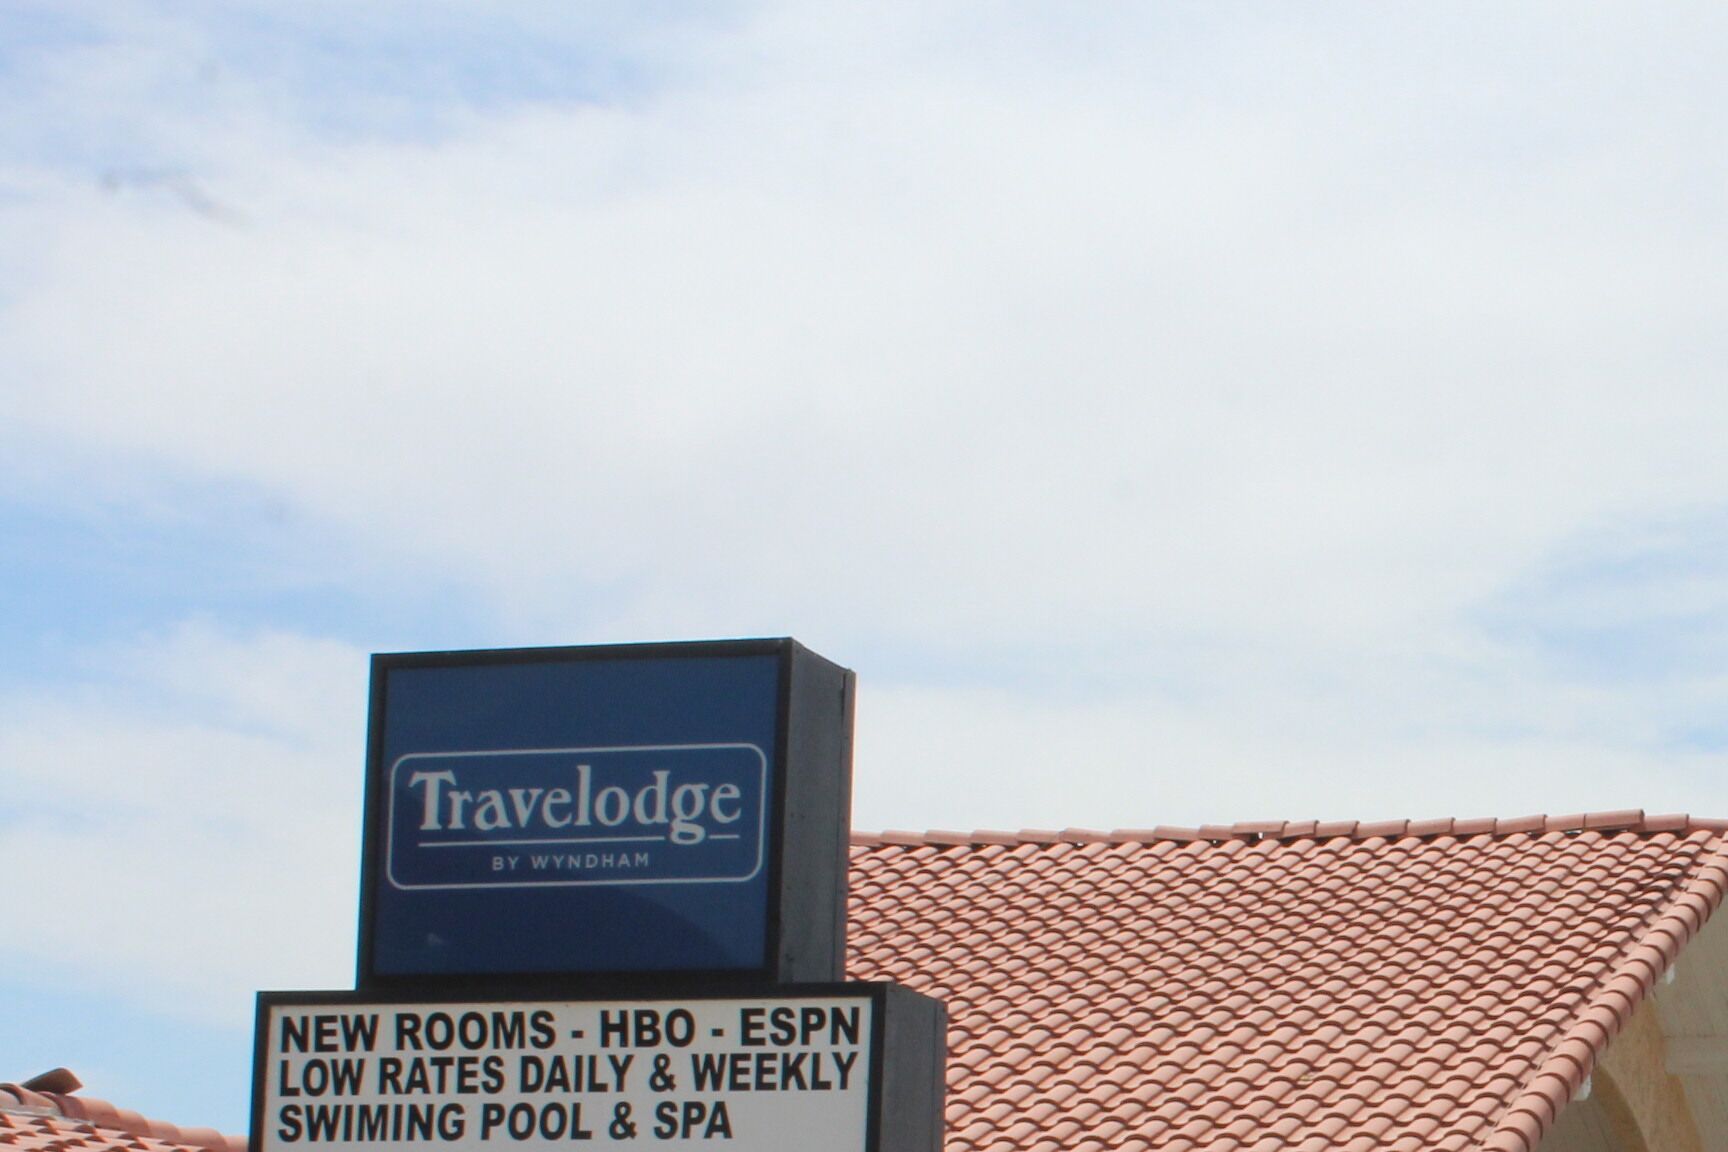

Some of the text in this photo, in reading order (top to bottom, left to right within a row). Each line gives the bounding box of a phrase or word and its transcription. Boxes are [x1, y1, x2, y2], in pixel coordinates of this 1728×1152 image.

[408, 765, 741, 845] Travelodge
[492, 853, 649, 871] BY WYNDHAM
[280, 1014, 379, 1053] NEW
[395, 1010, 556, 1051] ROOMS
[600, 1008, 696, 1048] HBO
[740, 1006, 860, 1047] ESPN
[280, 1051, 858, 1097] LOW RATES DAILY & WEEKLY
[278, 1100, 733, 1143] SWIMING POOL & SPA
